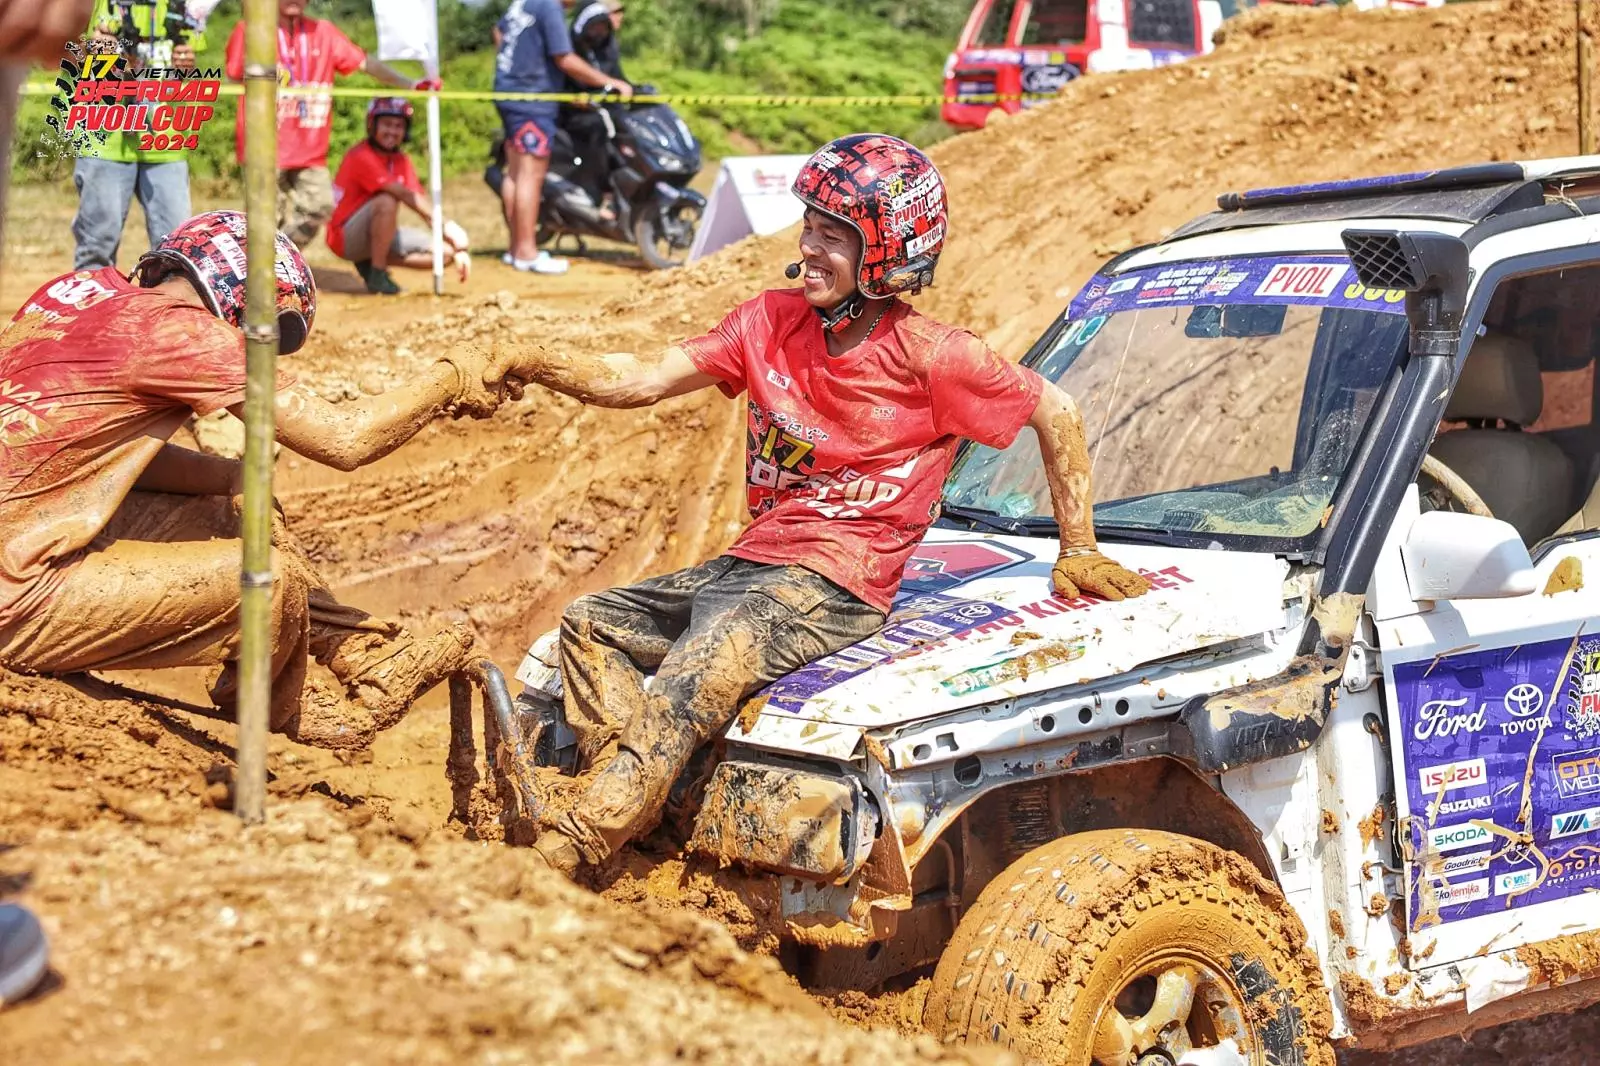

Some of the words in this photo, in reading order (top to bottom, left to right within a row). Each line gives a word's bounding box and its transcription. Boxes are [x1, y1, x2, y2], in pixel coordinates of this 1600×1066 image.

[894, 197, 928, 226] PVOIL
[922, 225, 941, 246] PVOIL
[1263, 266, 1333, 295] PVOIL
[760, 425, 815, 469] 17
[1415, 697, 1487, 740] Ford
[1500, 716, 1553, 736] TOYOTA
[1426, 766, 1481, 787] ISUZU
[1439, 795, 1492, 815] SUZUKI
